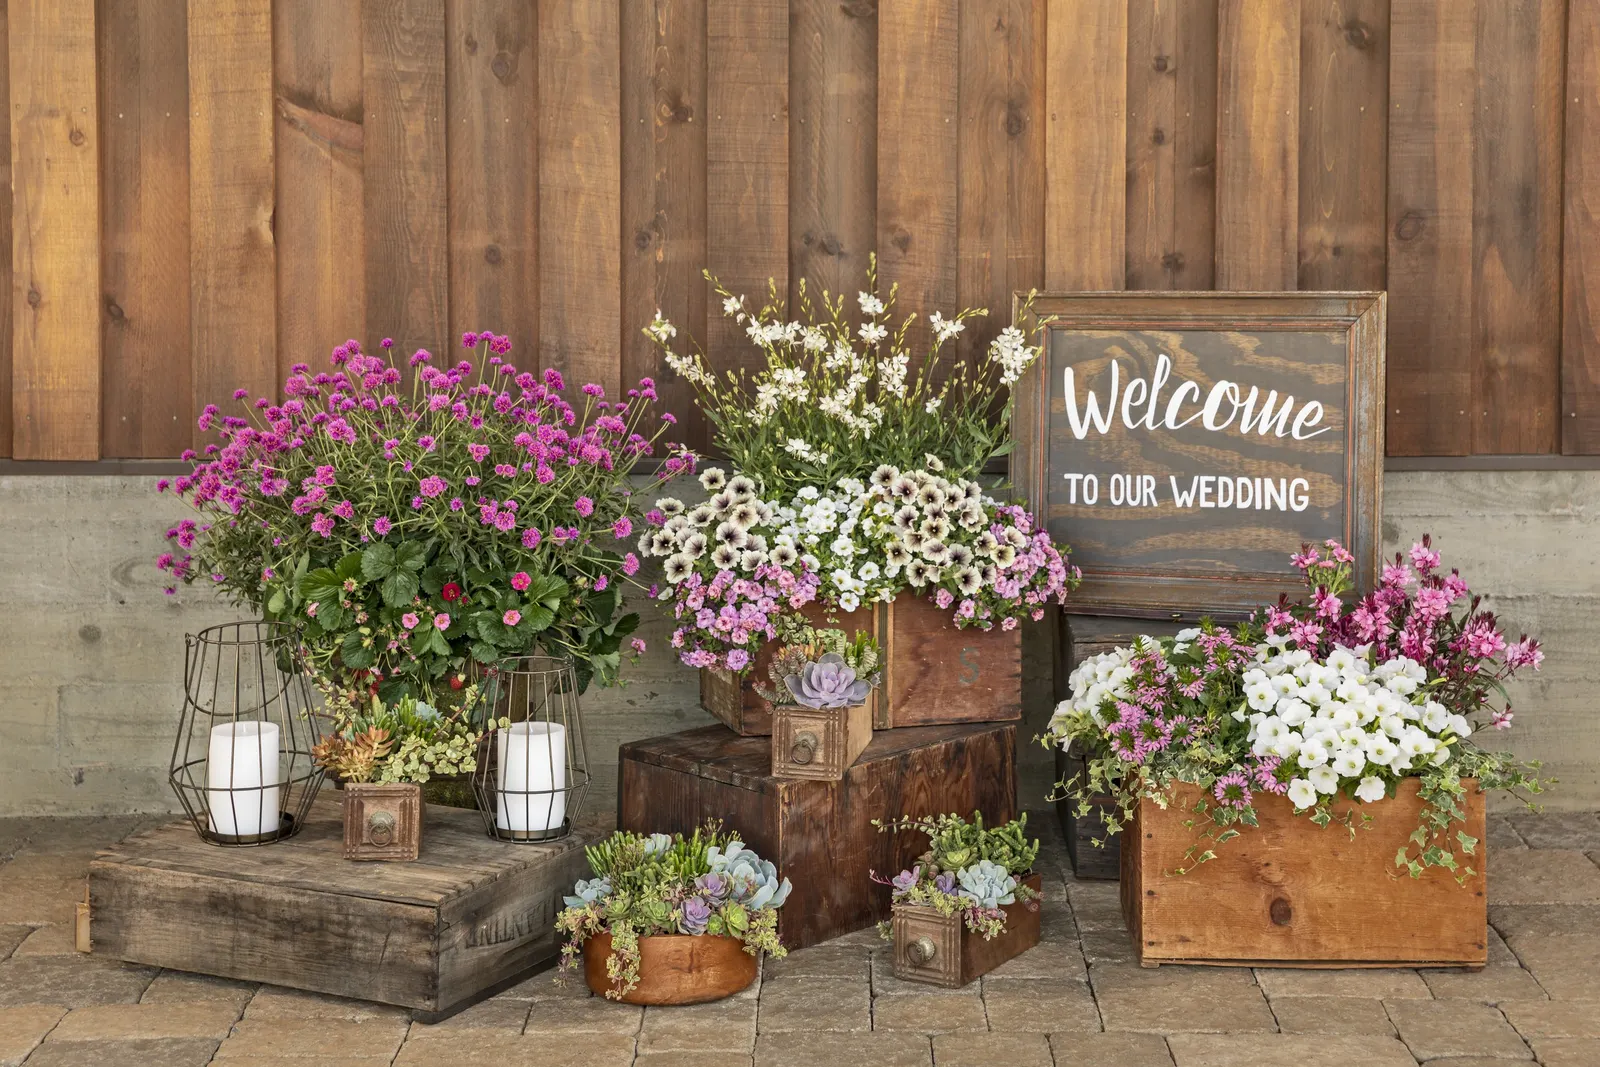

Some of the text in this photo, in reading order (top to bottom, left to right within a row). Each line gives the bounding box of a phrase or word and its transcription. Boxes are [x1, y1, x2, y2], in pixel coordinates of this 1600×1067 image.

[1064, 354, 1331, 440] Welcome
[1064, 473, 1309, 512] TO OUR WEDDING
[958, 647, 981, 685] S
